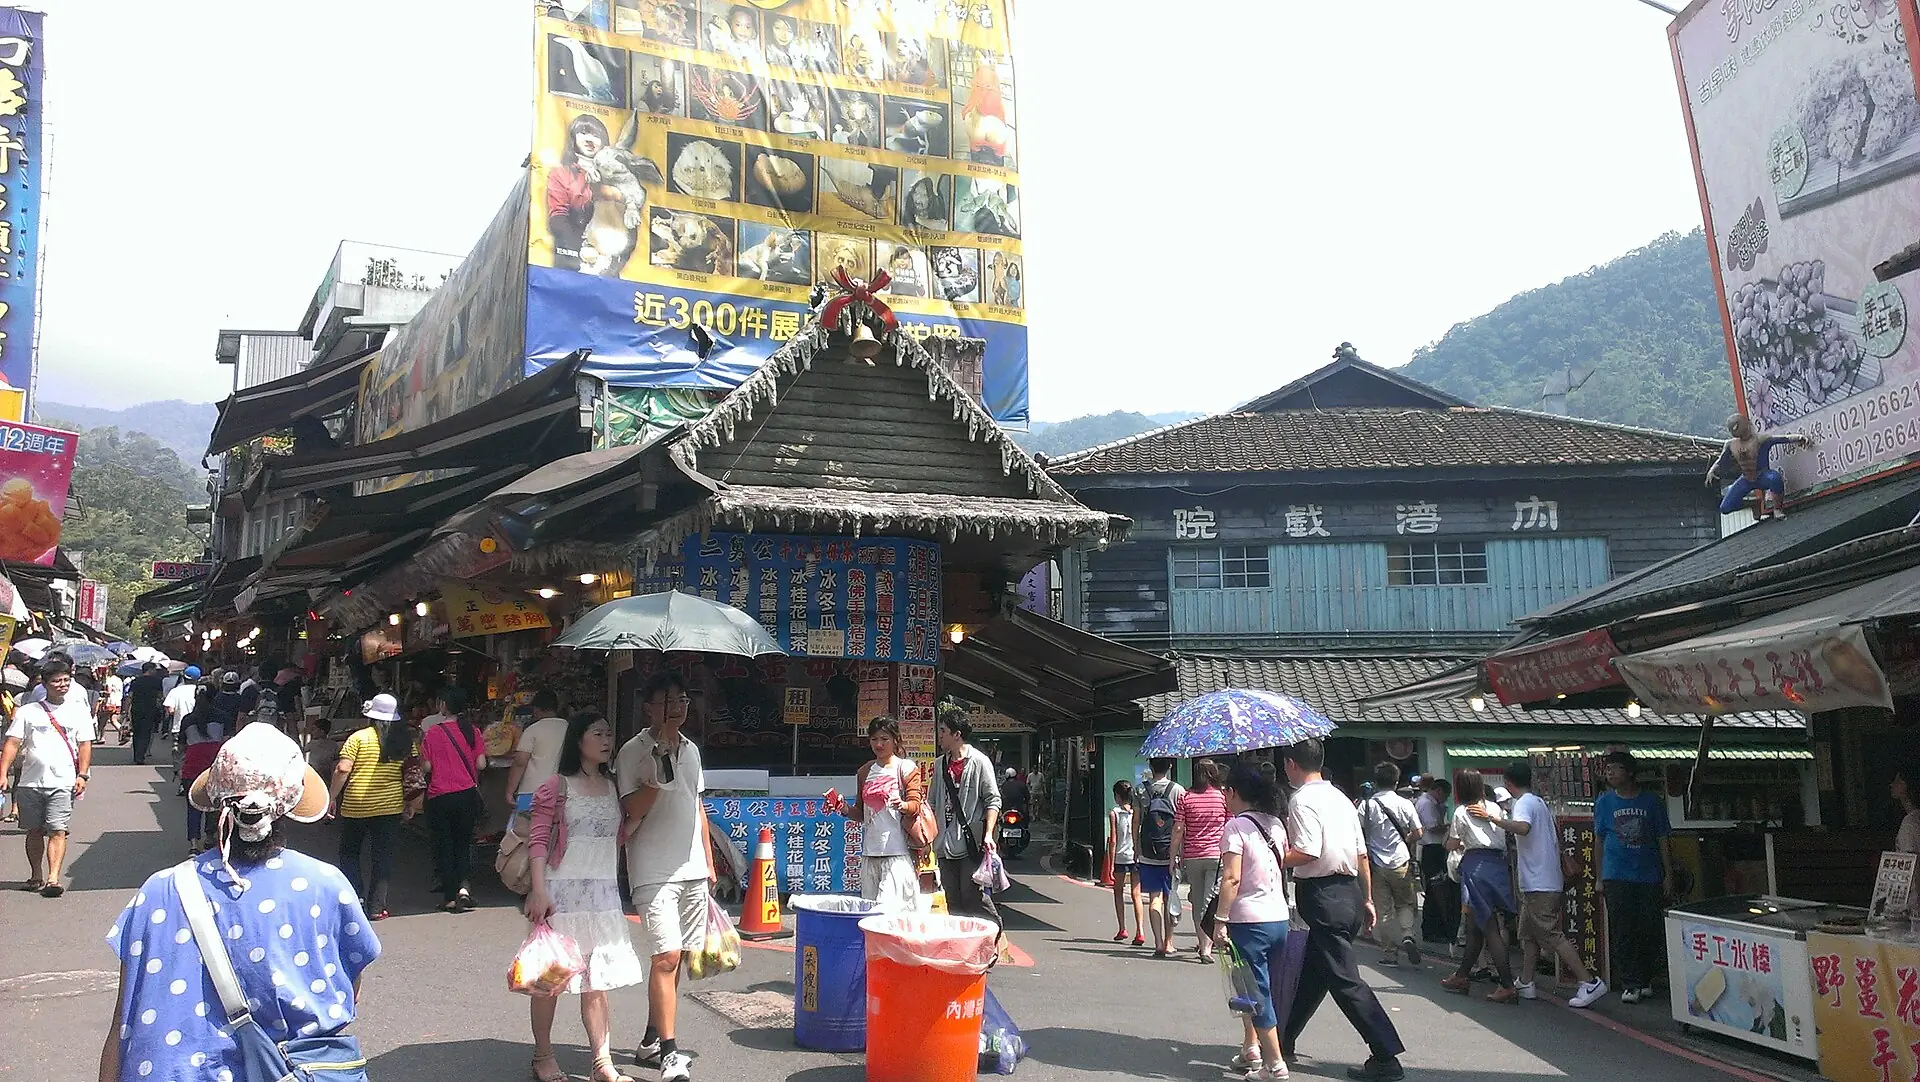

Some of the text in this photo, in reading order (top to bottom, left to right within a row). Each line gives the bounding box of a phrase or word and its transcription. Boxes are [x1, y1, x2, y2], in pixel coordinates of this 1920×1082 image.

[633, 290, 806, 341] 近300件展
[787, 822, 806, 891] 冰桂花釀茶
[814, 822, 832, 891] 冰冬瓜茶
